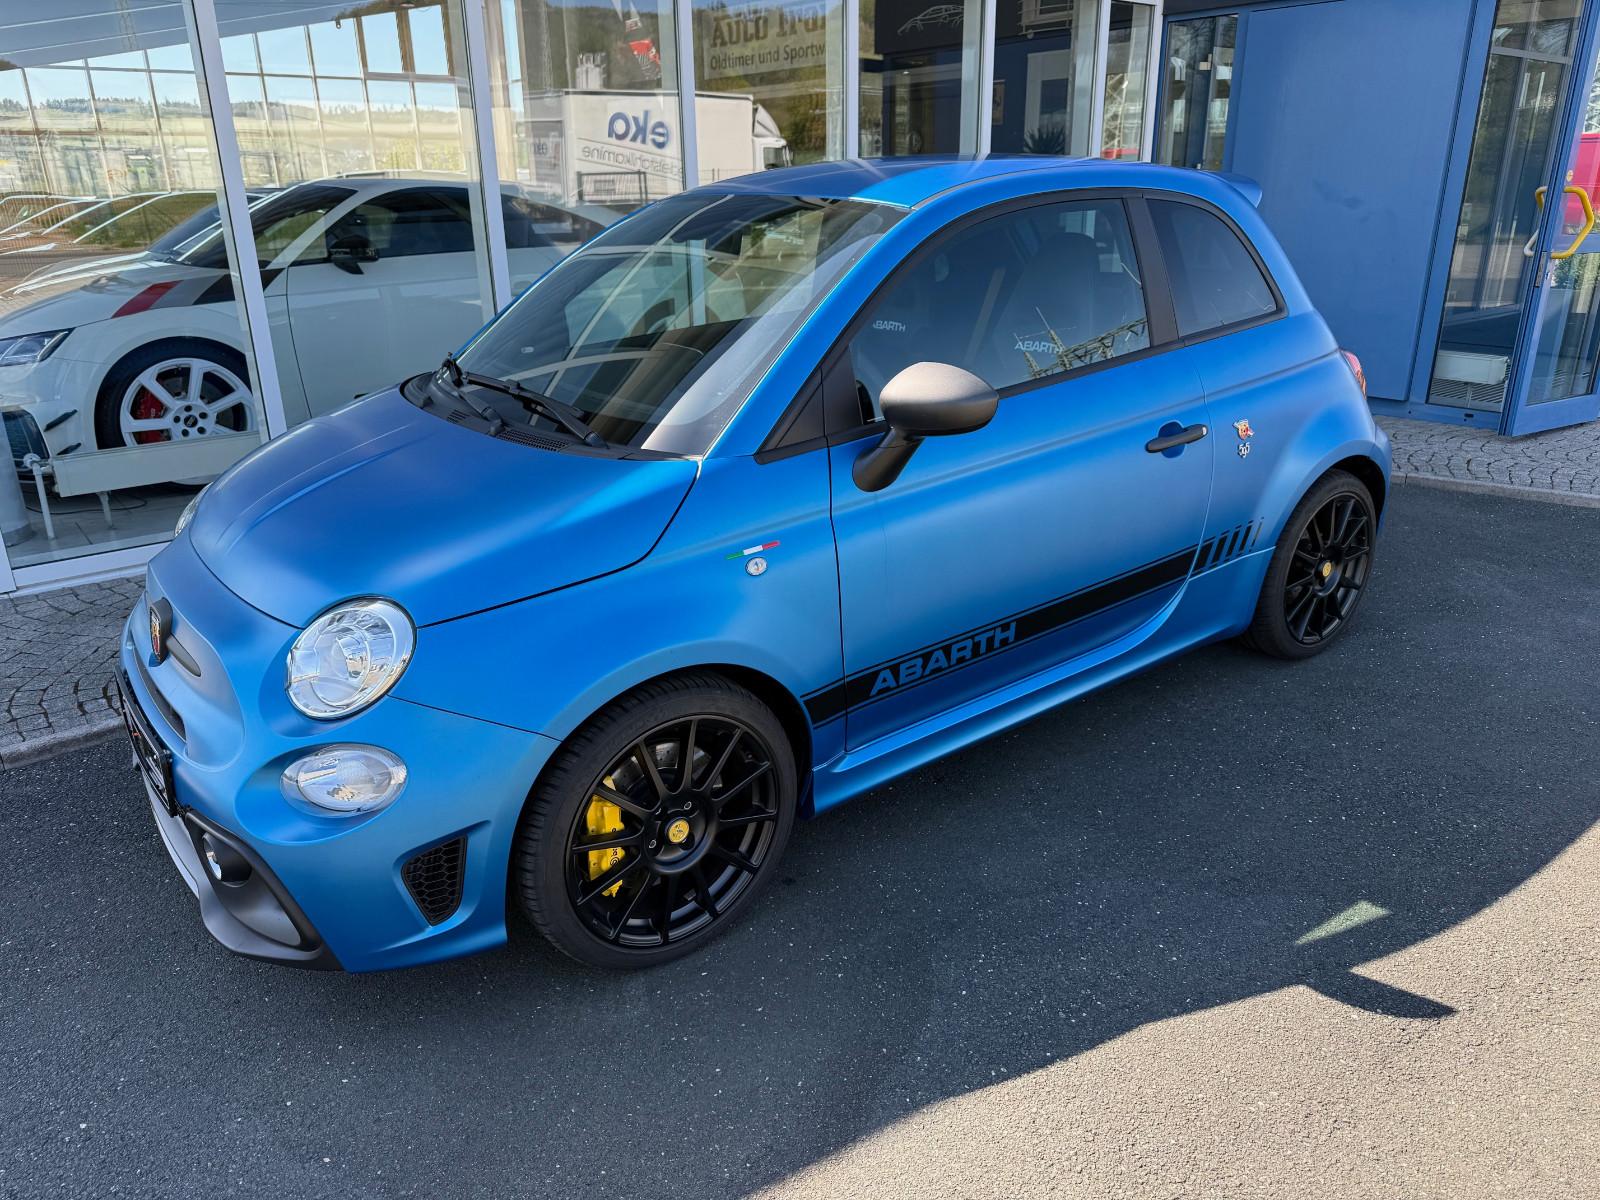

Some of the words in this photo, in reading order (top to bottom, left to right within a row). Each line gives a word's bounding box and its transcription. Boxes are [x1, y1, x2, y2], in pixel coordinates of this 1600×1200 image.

[710, 52, 756, 70] Oldtimer
[758, 45, 780, 65] und
[1014, 340, 1063, 355] ABARTH
[1238, 442, 1250, 458] 595
[869, 620, 1017, 697] ABARTH
